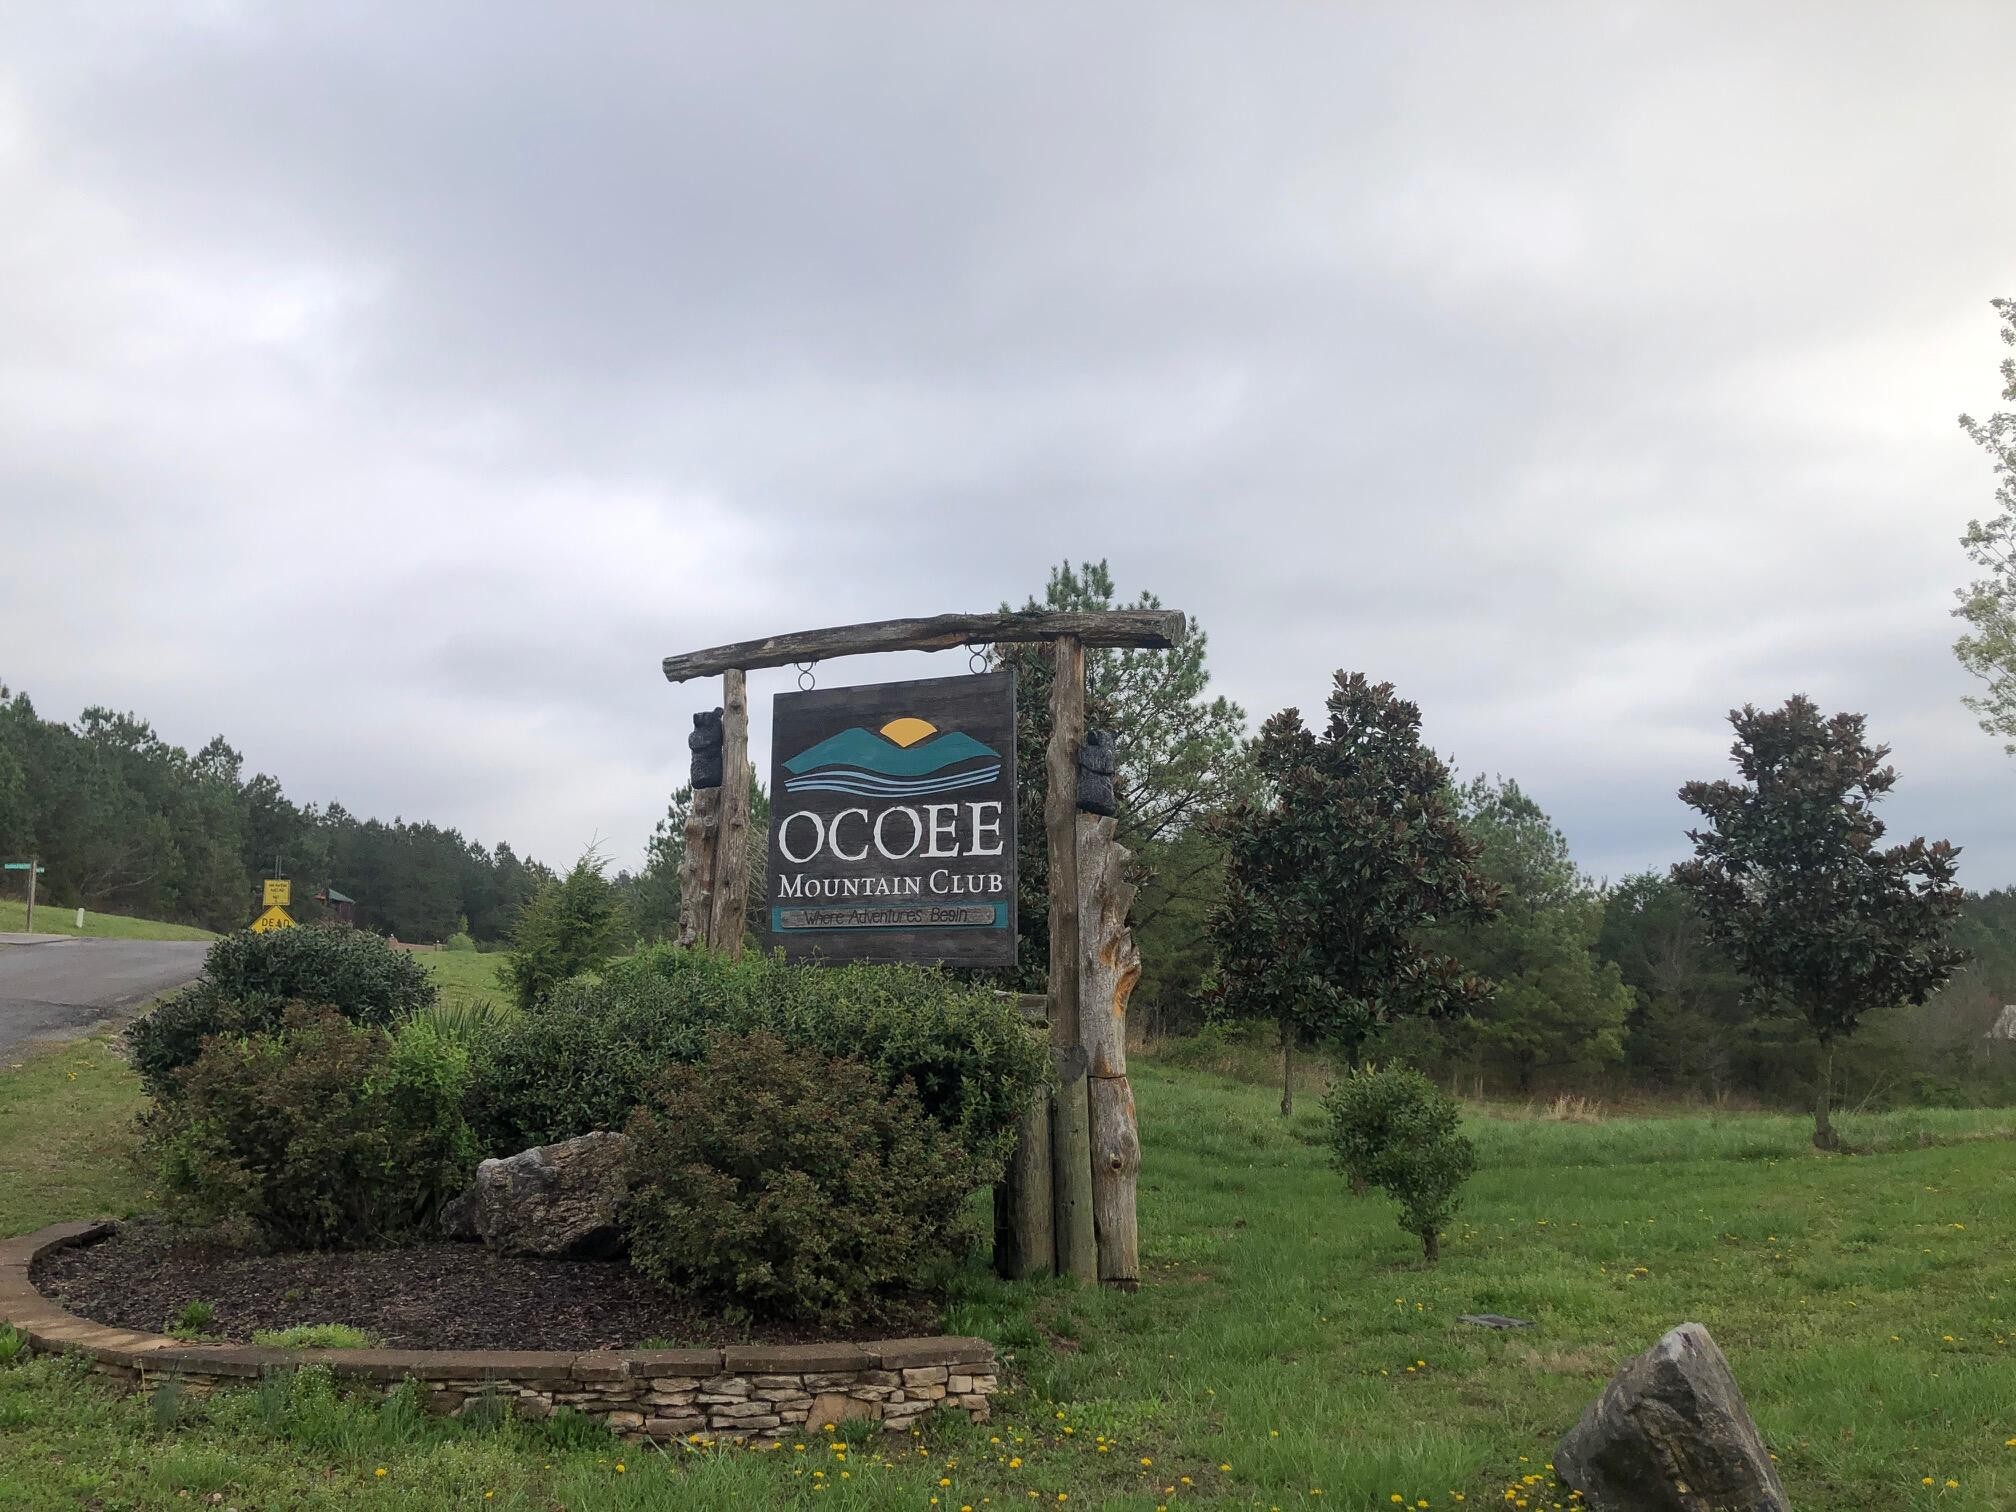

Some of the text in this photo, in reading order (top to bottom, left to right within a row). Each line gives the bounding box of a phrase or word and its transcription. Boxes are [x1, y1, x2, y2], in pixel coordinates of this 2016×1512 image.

[778, 801, 1004, 863] OCOEE
[261, 918, 290, 928] DEAD
[804, 907, 968, 925] Where Adventures Begin
